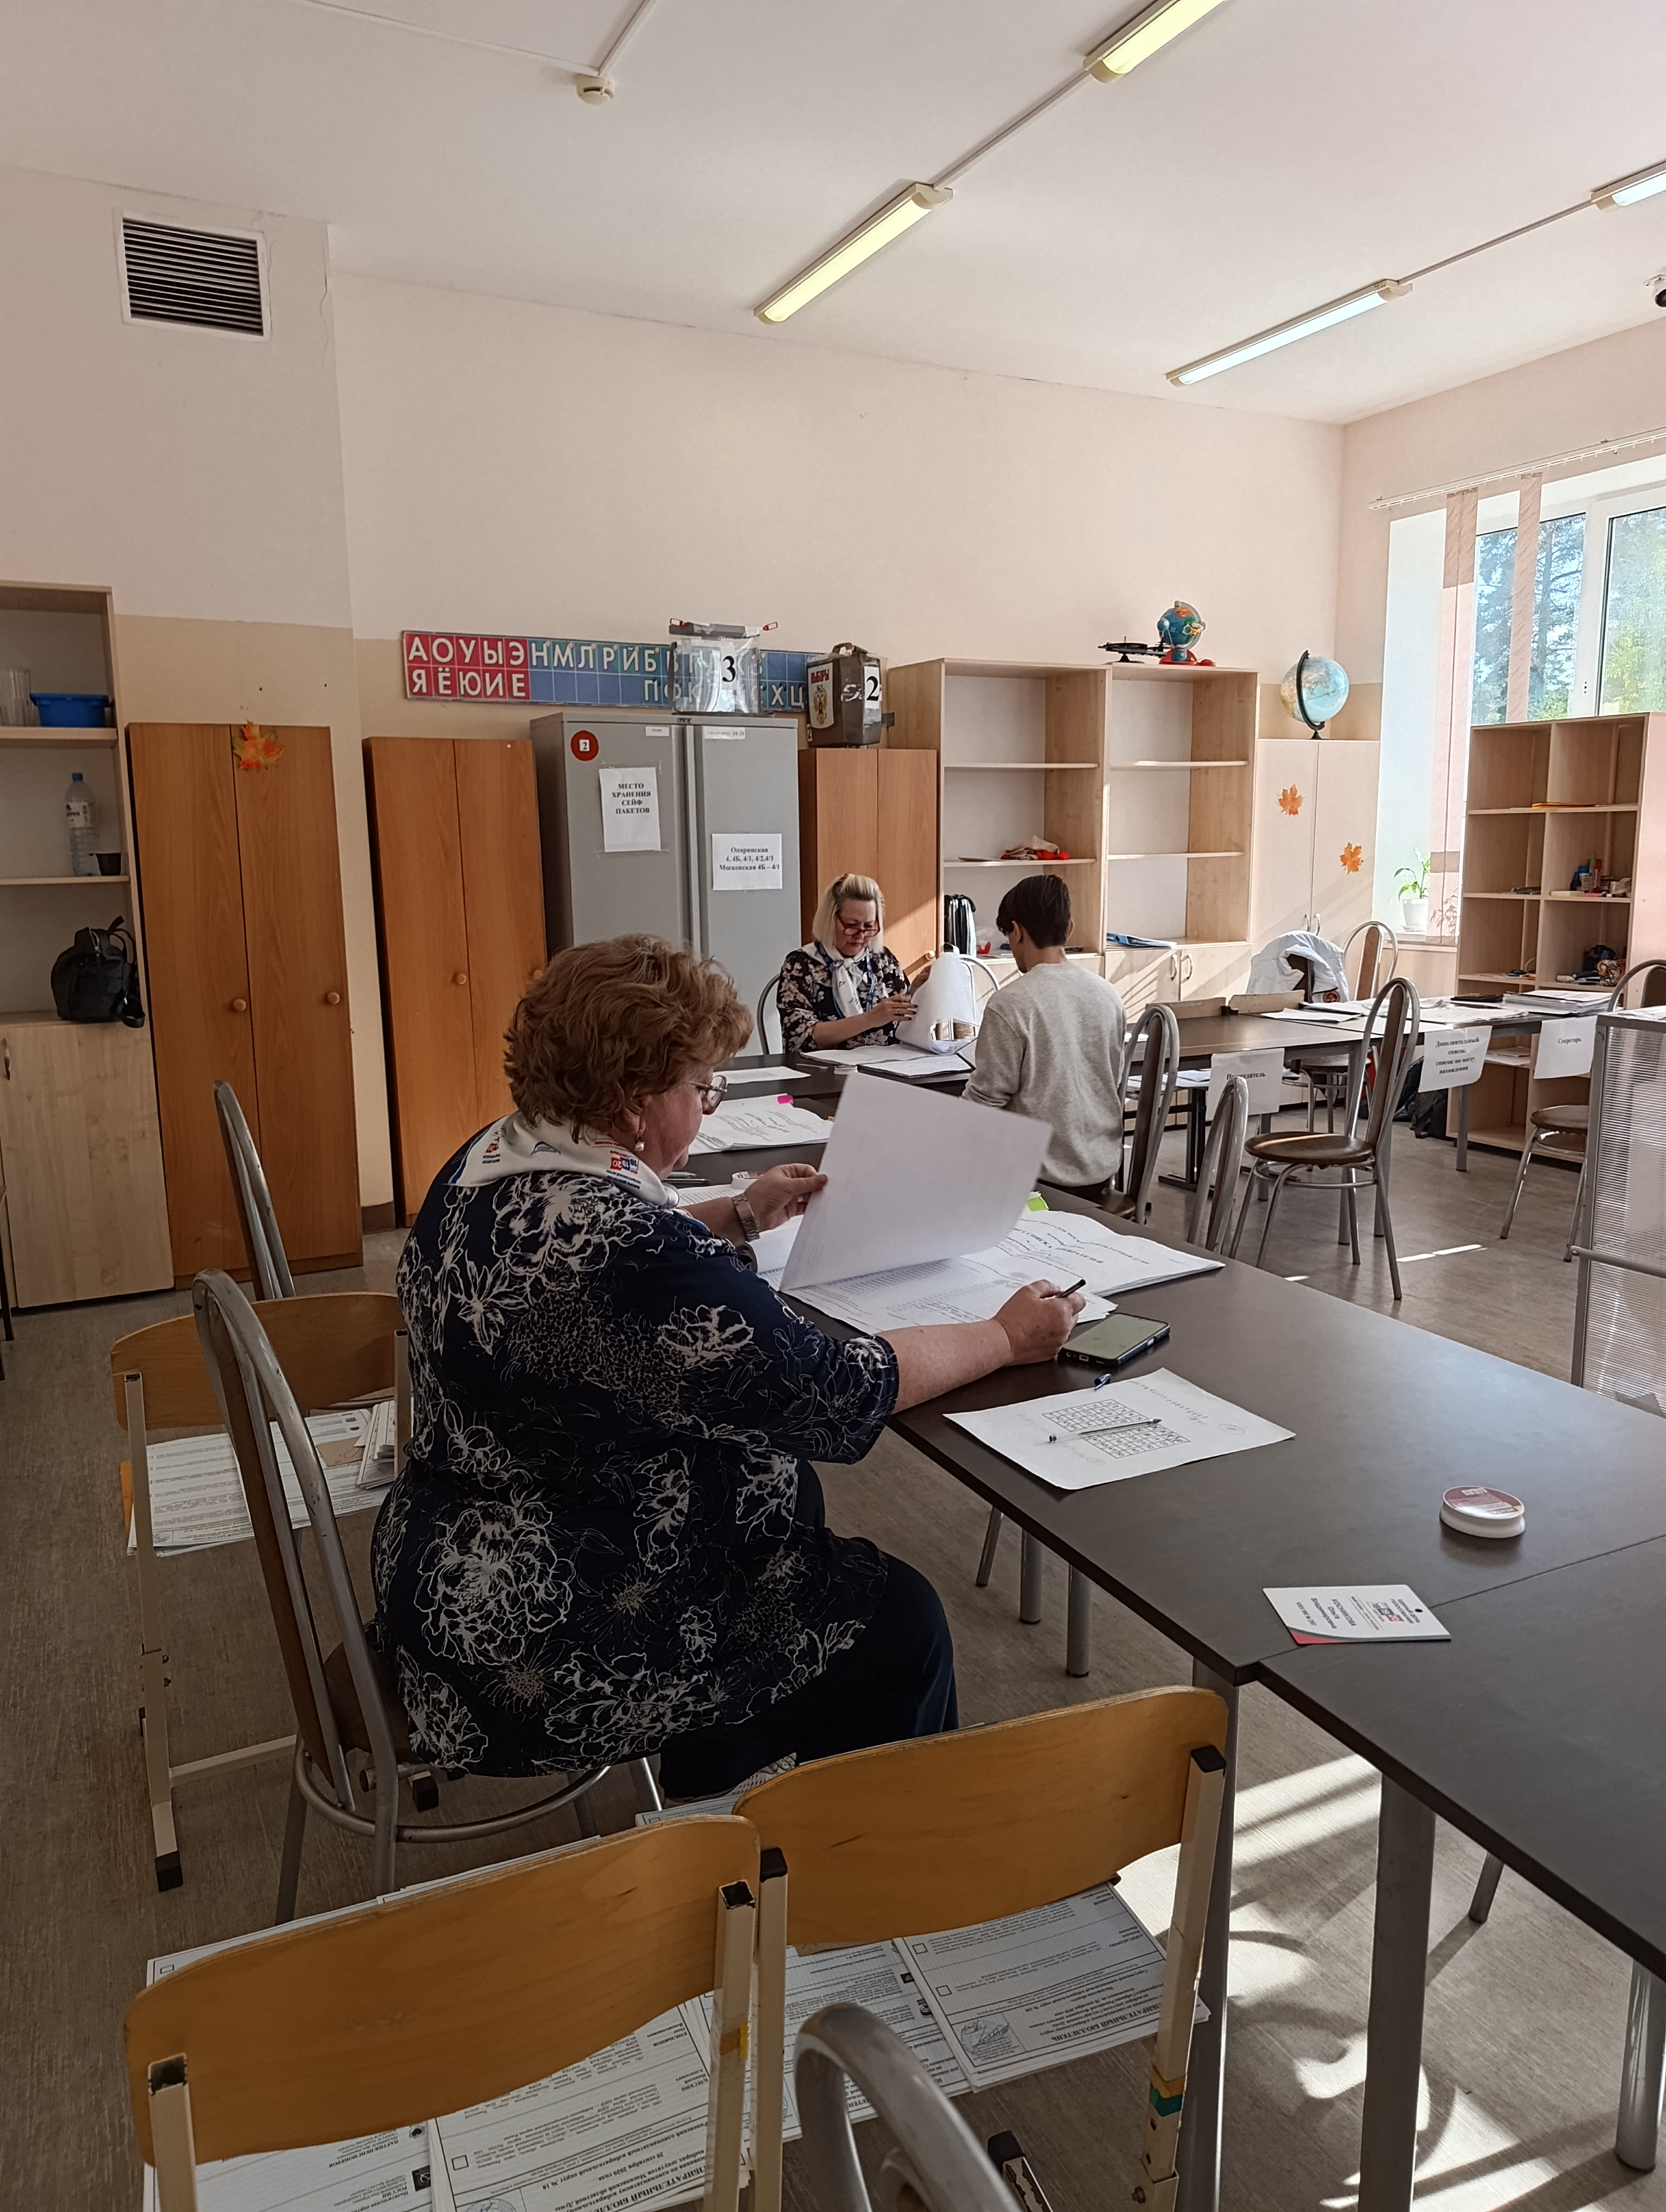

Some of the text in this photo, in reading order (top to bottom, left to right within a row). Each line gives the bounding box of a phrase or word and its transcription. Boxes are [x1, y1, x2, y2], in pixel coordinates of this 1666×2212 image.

[722, 655, 736, 683] 3
[811, 669, 829, 684] ВЫБОРЫ
[866, 676, 880, 701] 2
[1436, 1037, 1479, 1047] Дополнительный
[1439, 1066, 1468, 1075] нахождения
[612, 1159, 621, 1168] 20
[1310, 1598, 1339, 1629] Владимировна
[1325, 1606, 1341, 1619] Ольга
[1330, 1598, 1358, 1626] КОСНИКОВА
[1050, 2023, 1100, 2042] БЮЛЛЕТЕНЬ
[676, 2120, 708, 2139] Раменский
[626, 2132, 675, 2157] одномандатный
[578, 2151, 626, 2177] избирательный
[597, 2151, 664, 2183] 20 сентября 2026 года
[554, 2149, 704, 2212] выборах депутатов Московской областной Думы
[559, 2171, 578, 2184] округ
[618, 2170, 669, 2195] одномандатному
[564, 2190, 617, 2212] избирательному
